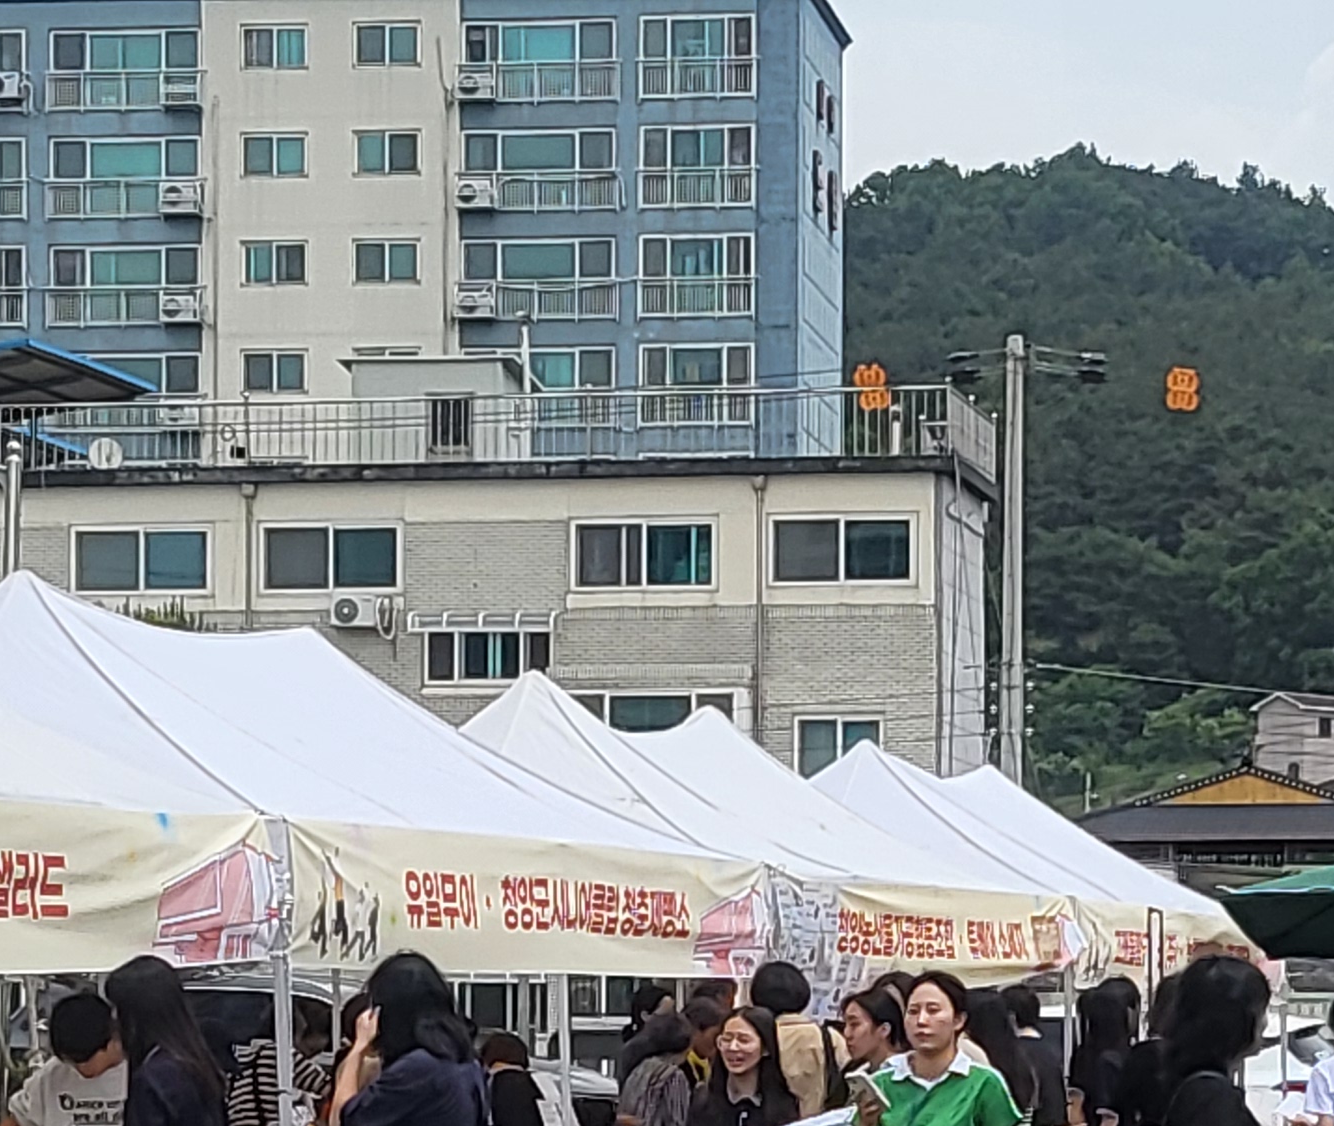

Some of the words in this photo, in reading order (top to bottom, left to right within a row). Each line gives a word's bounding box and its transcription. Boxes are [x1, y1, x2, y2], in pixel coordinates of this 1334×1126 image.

[405, 869, 479, 930] 유일무이
[500, 874, 619, 936] 청양군시니어클럽
[620, 886, 691, 938] 청춘제빵소
